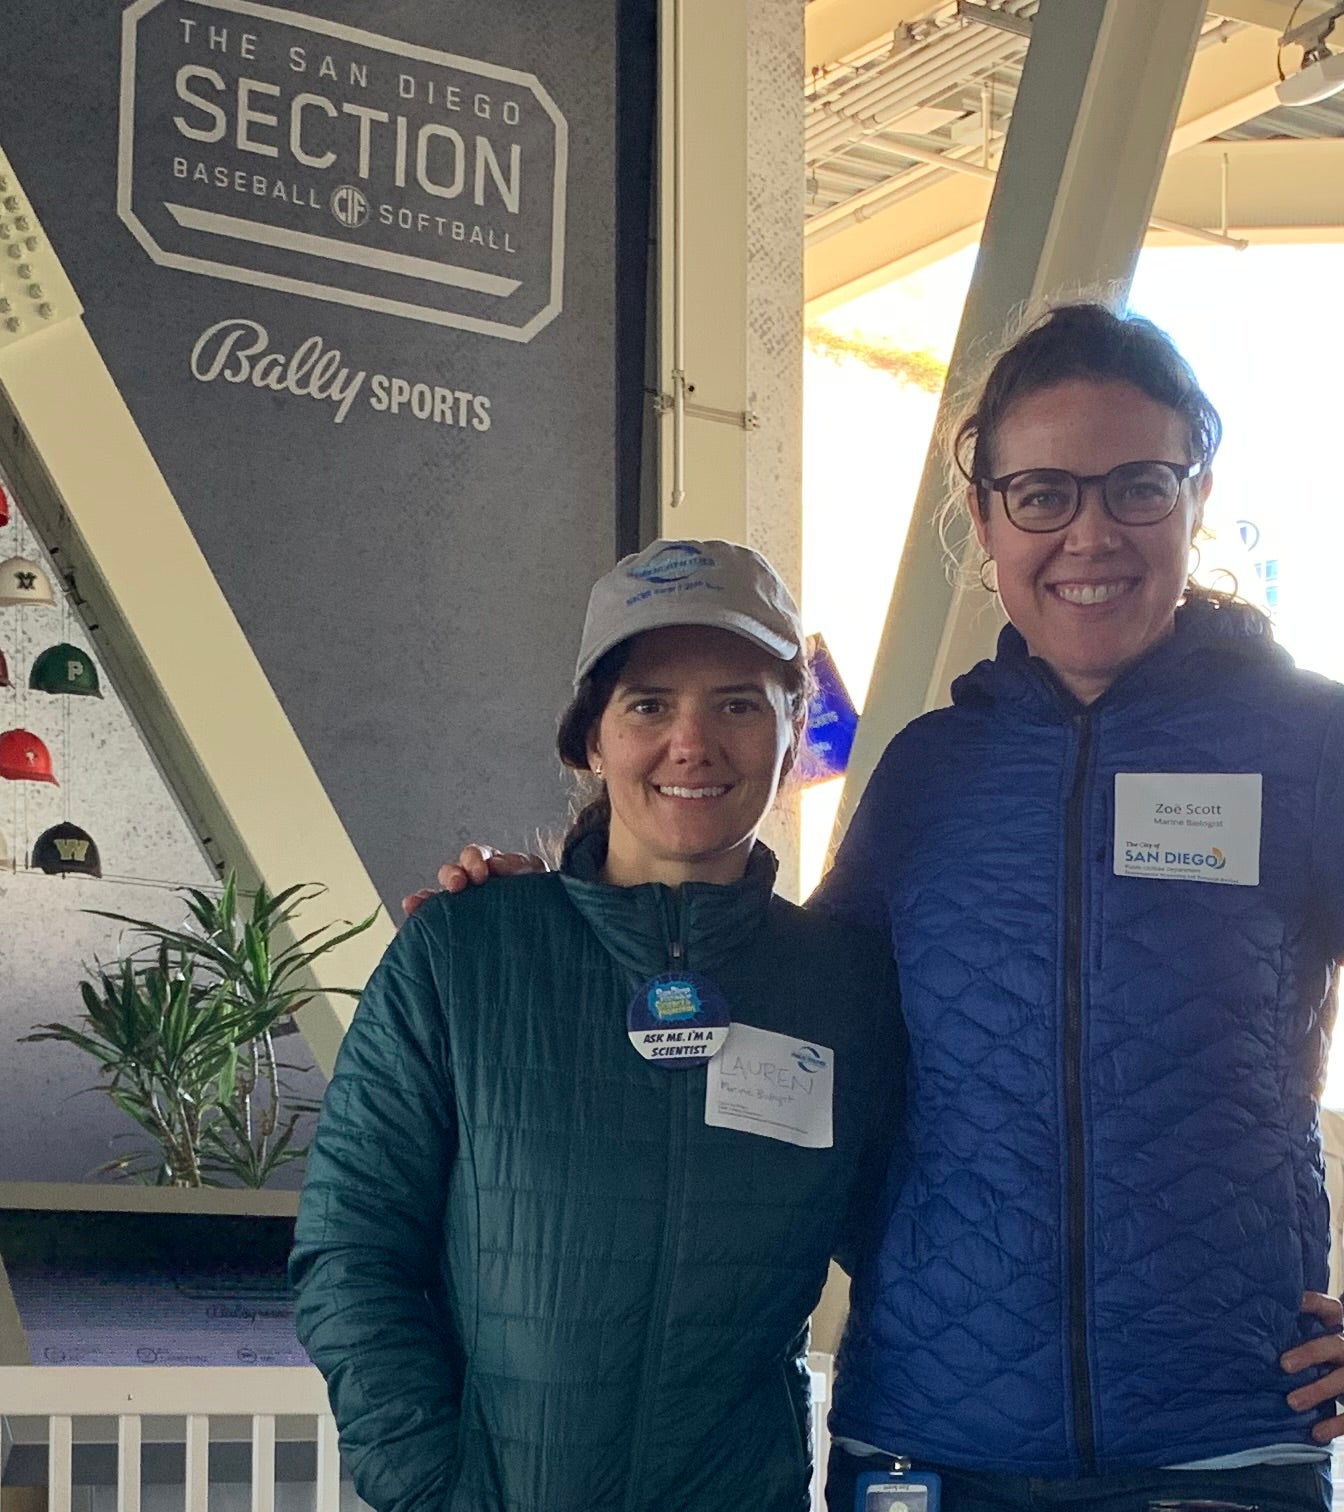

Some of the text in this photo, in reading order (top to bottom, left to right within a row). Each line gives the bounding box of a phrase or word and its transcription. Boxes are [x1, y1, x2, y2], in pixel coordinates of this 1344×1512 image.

[180, 19, 520, 125] THE SAN DIEGO
[172, 64, 522, 215] SECTION
[173, 158, 322, 210] BASEBALL
[379, 204, 517, 253] SOFTBALL
[190, 318, 492, 432] Bally SPORTS
[68, 661, 84, 680] P
[1186, 803, 1223, 815] Scott
[54, 837, 88, 861] W
[1125, 849, 1219, 869] SAN DIEGO
[643, 1033, 665, 1044] ASK
[705, 1031, 714, 1041] A
[651, 1044, 708, 1057] SCIENTIST
